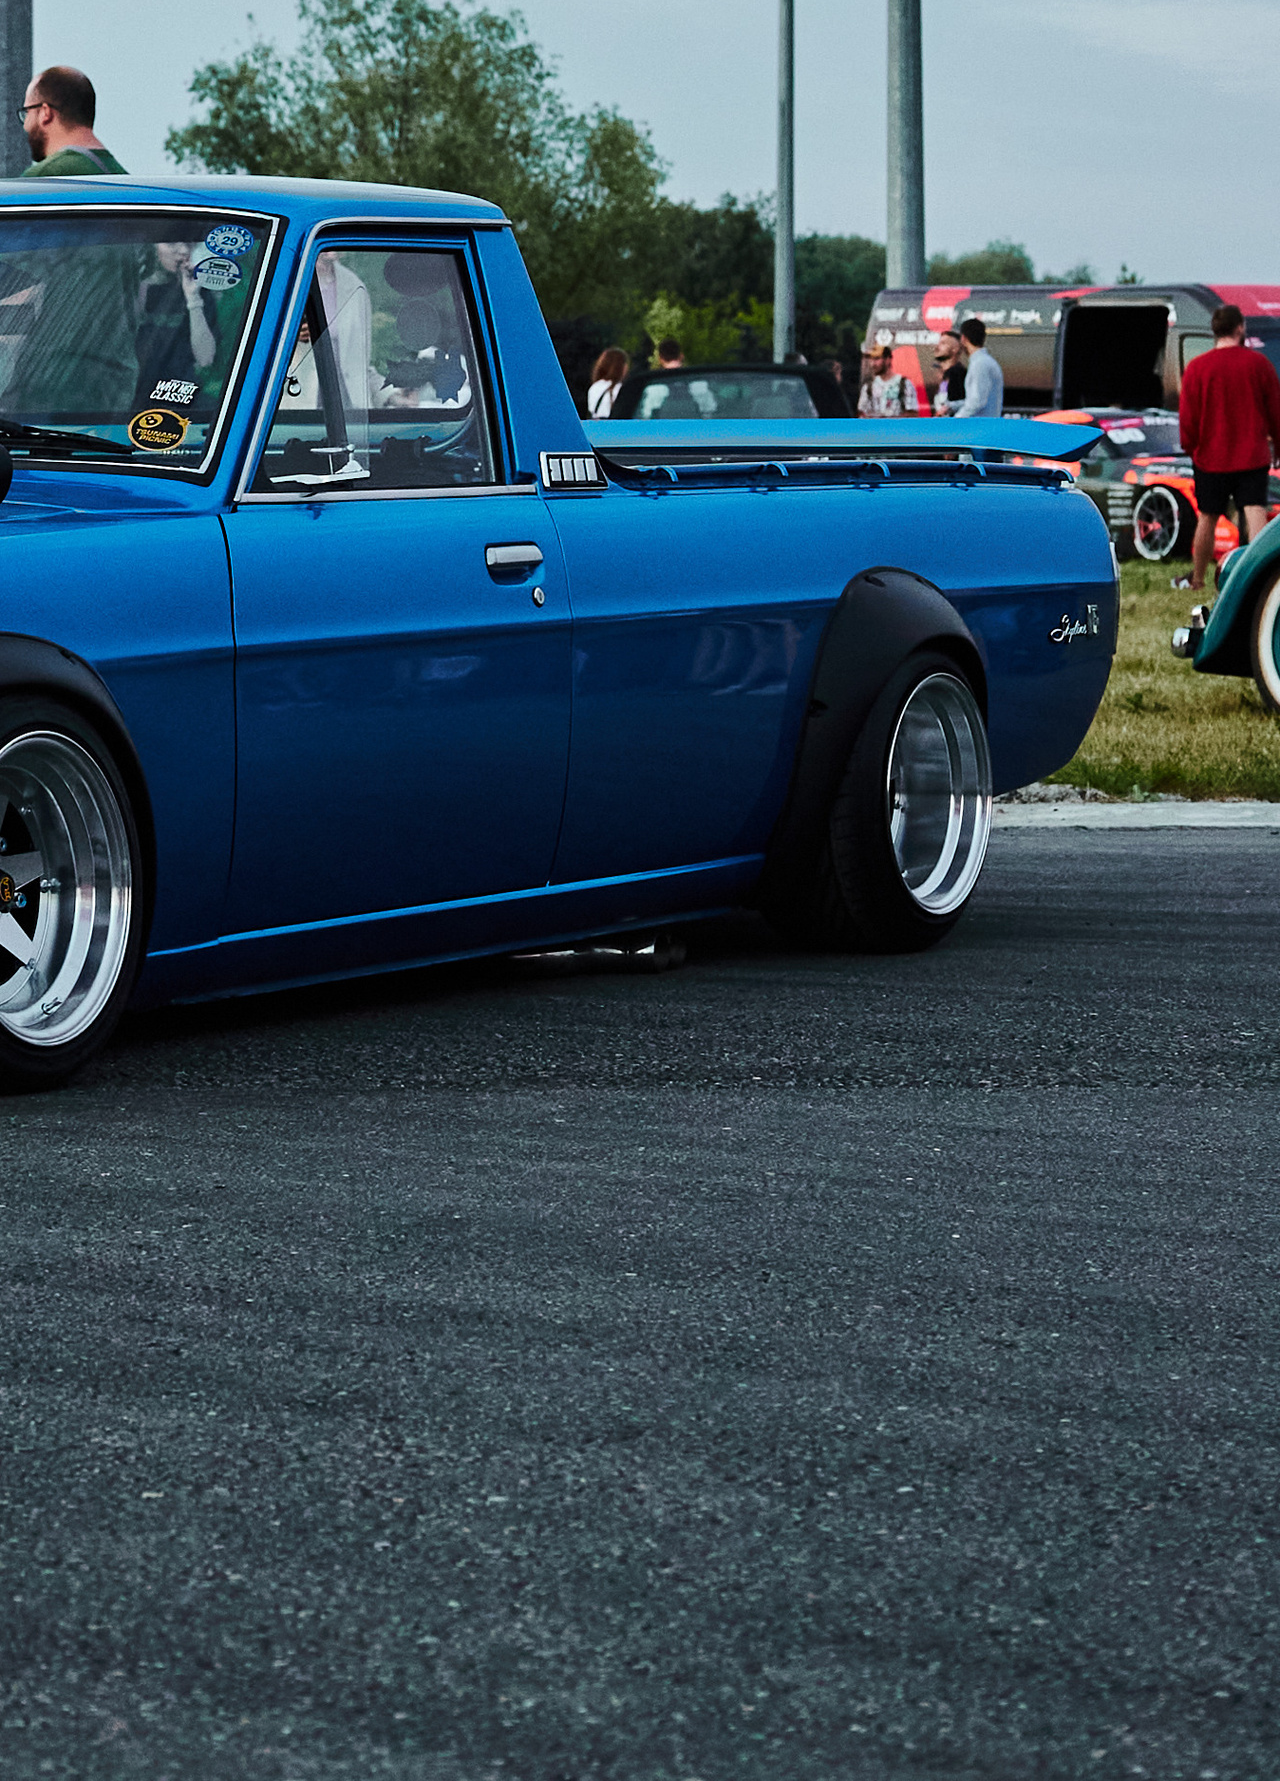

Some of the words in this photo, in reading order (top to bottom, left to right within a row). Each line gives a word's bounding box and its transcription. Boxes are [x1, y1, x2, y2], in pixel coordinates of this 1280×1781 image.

[221, 236, 238, 247] 29
[156, 380, 180, 393] WHY
[177, 384, 199, 395] NOT
[150, 390, 193, 404] CLASSIC
[136, 428, 179, 440] TSUNAMI
[139, 433, 171, 444] PICNIC
